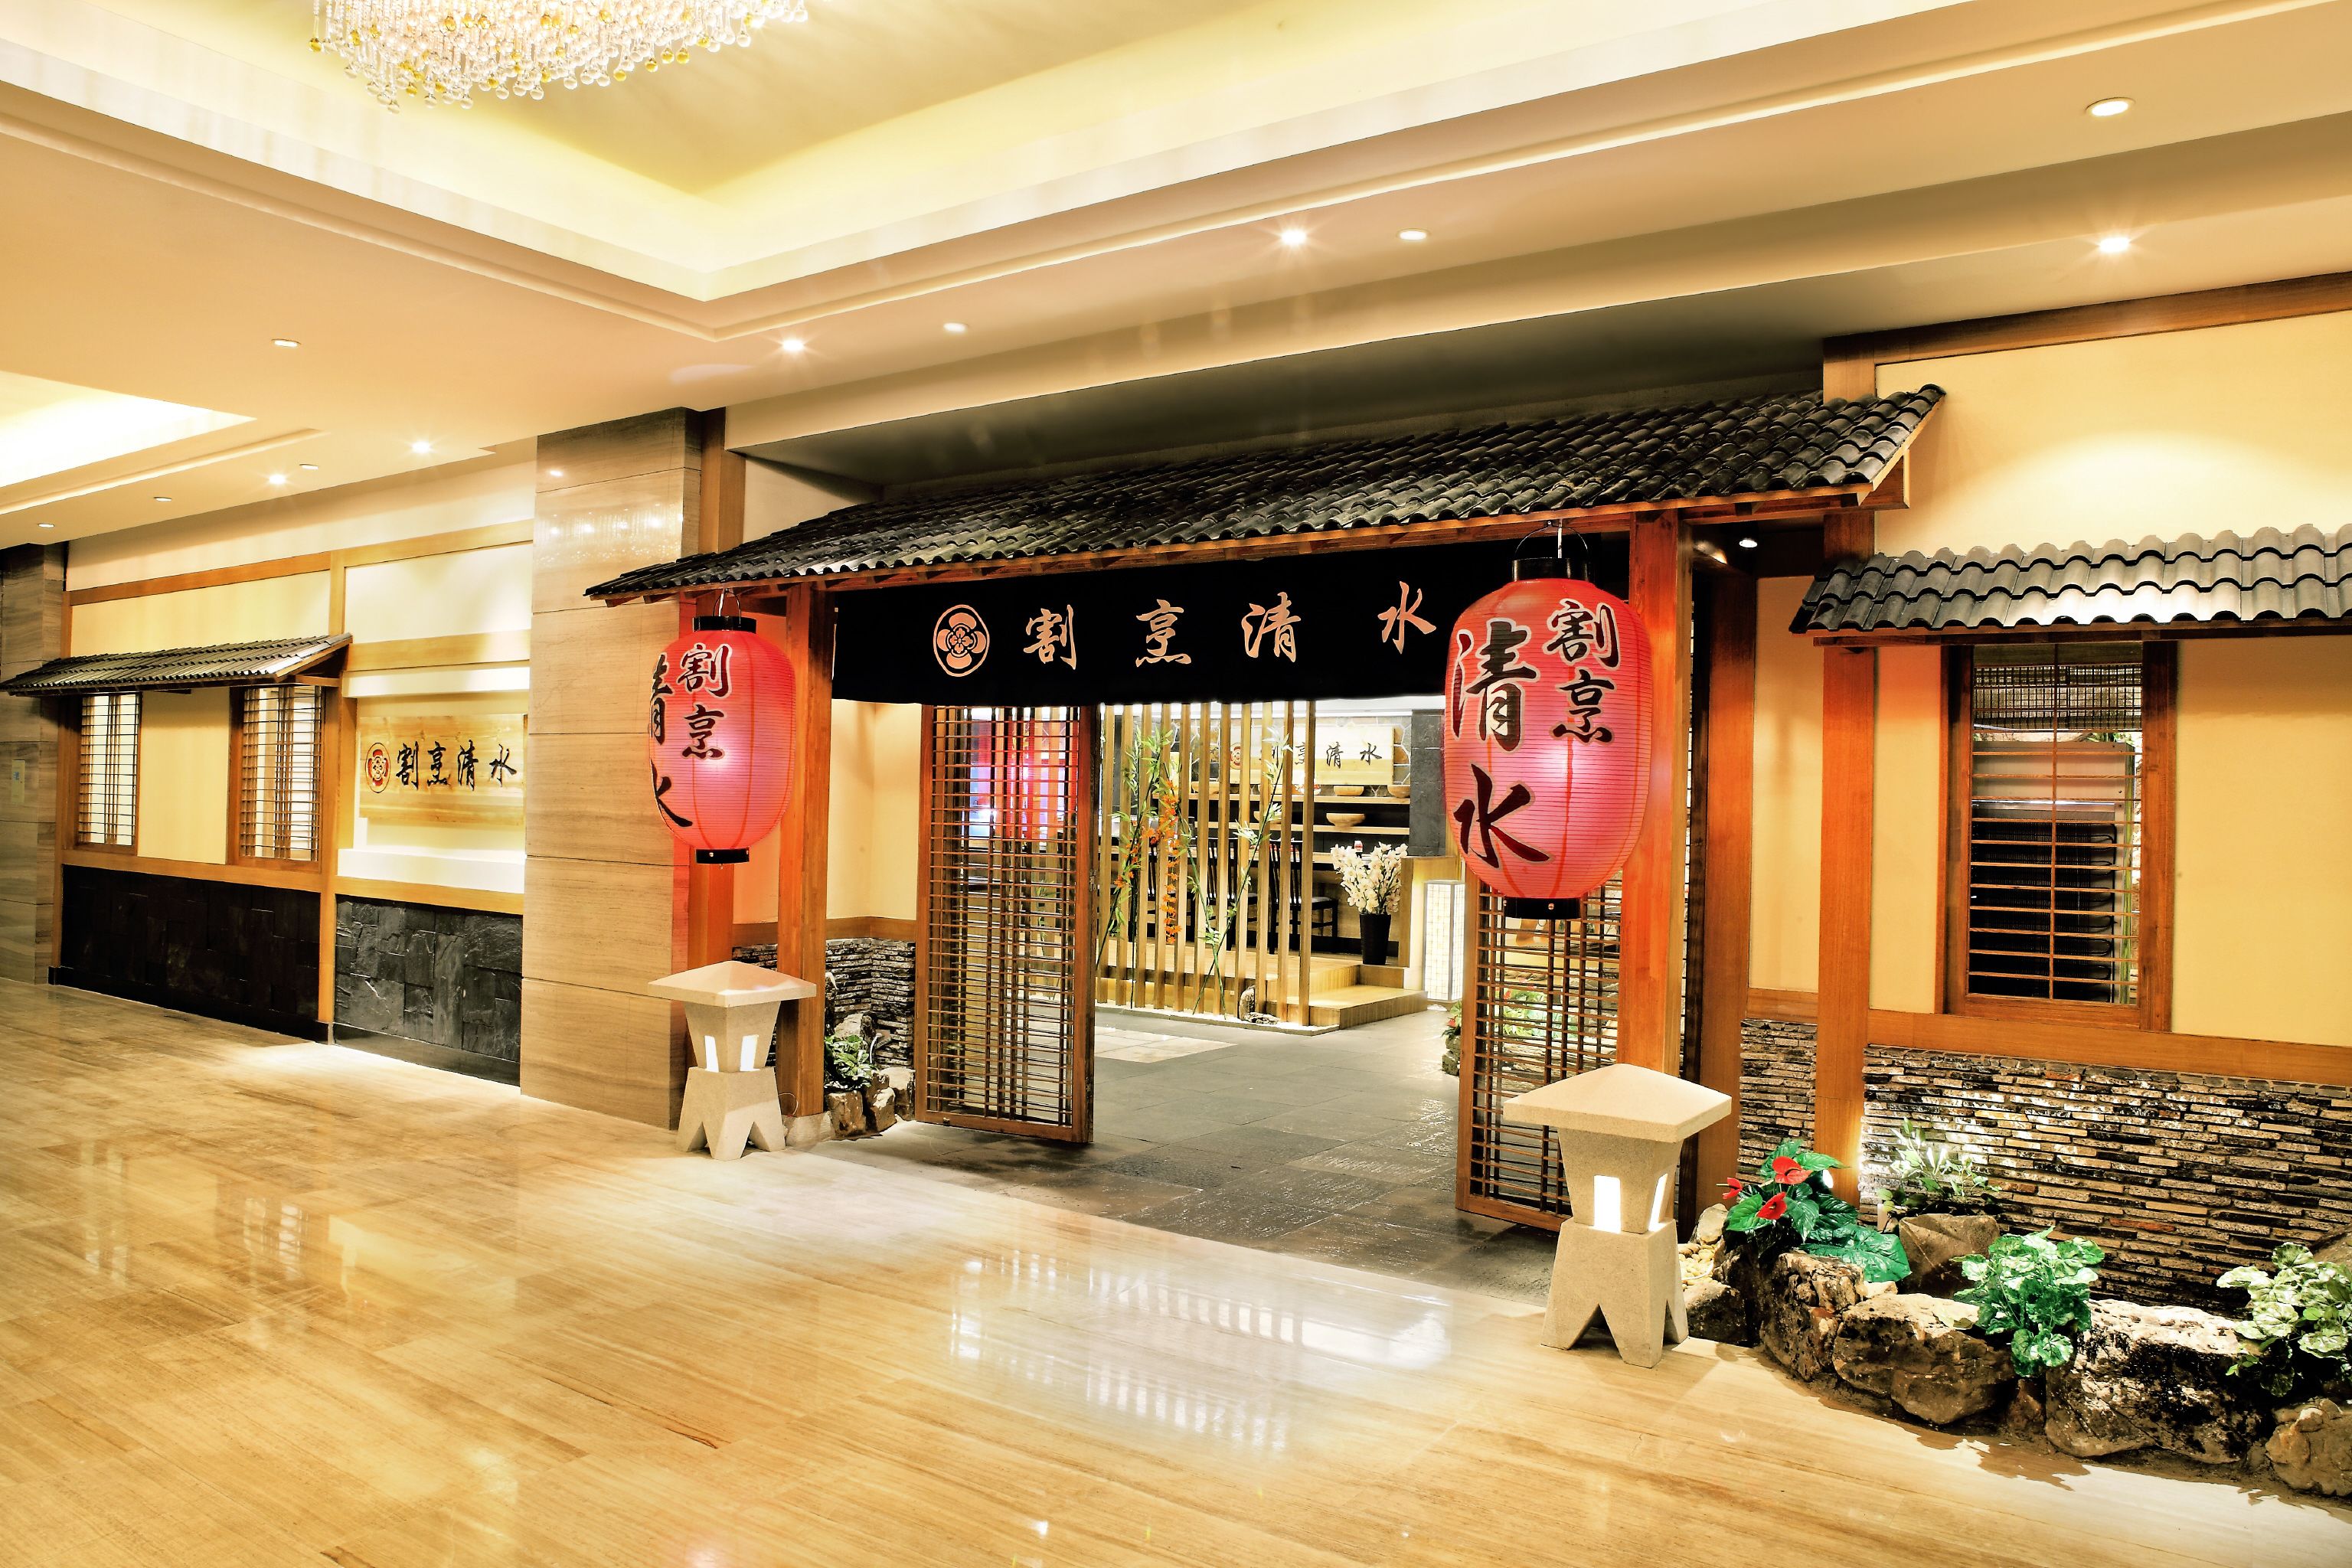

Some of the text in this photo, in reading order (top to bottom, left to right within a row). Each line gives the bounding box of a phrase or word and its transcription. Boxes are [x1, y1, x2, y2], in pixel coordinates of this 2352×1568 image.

[1023, 581, 1436, 670] 割烹清水
[1543, 598, 1621, 744] 割烹
[678, 642, 733, 760] 割烹
[1452, 618, 1553, 869] 清水
[396, 739, 518, 791] 割烹清水
